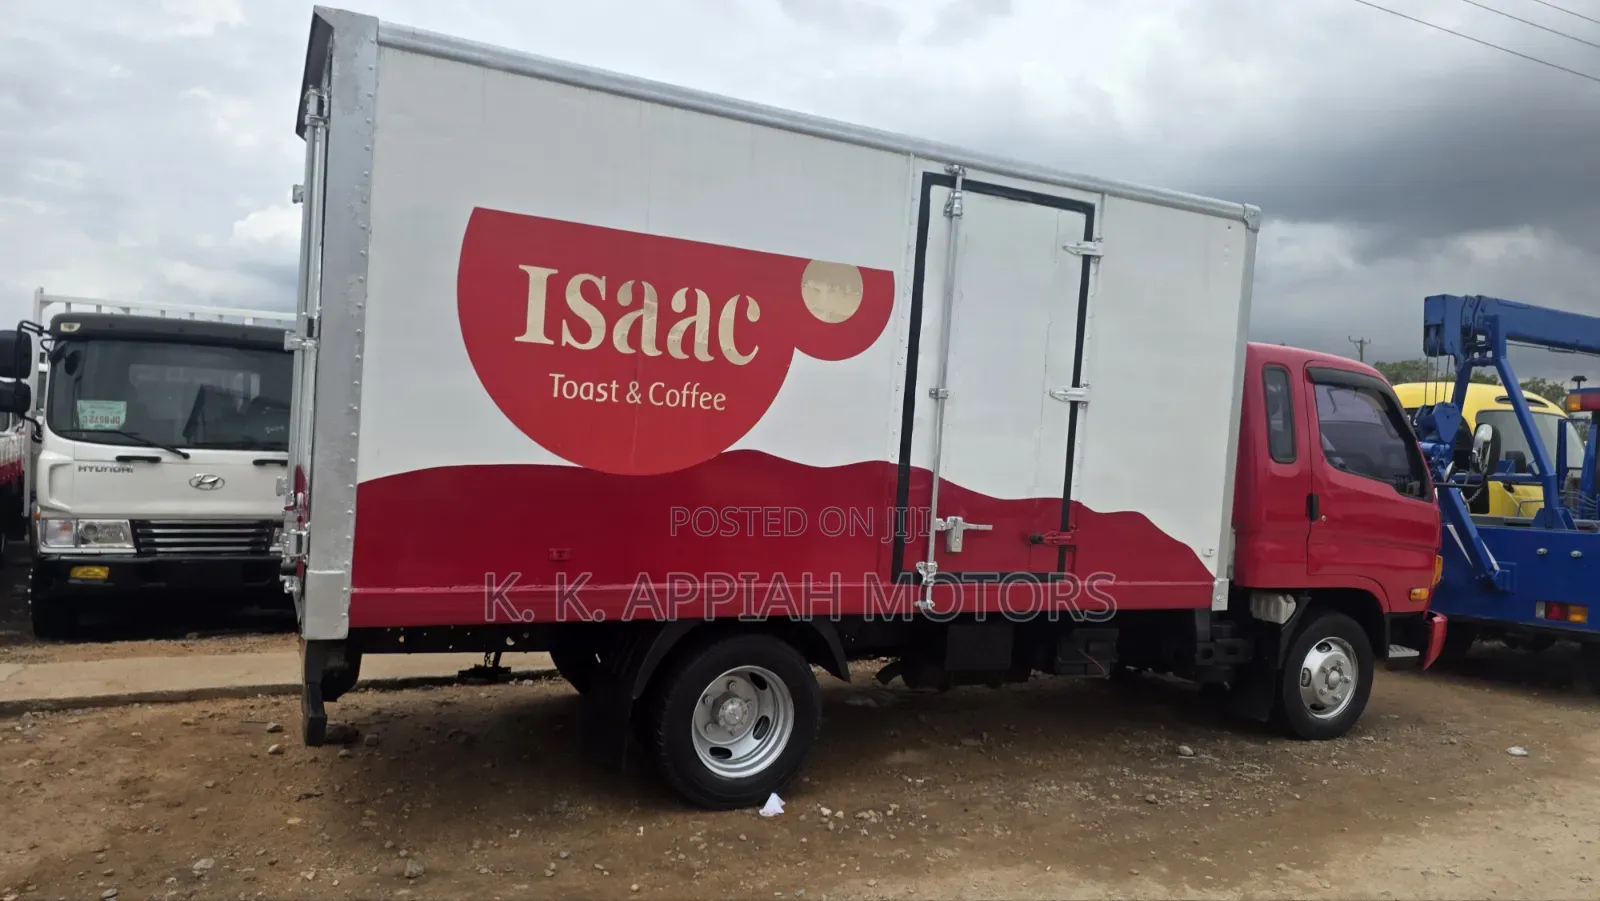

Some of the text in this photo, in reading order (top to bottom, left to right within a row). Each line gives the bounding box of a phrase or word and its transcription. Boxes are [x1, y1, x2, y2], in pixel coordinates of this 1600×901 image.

[514, 264, 761, 365] Isaac
[549, 373, 726, 411] Toast & Coffee
[78, 465, 134, 474] HYUNDAI
